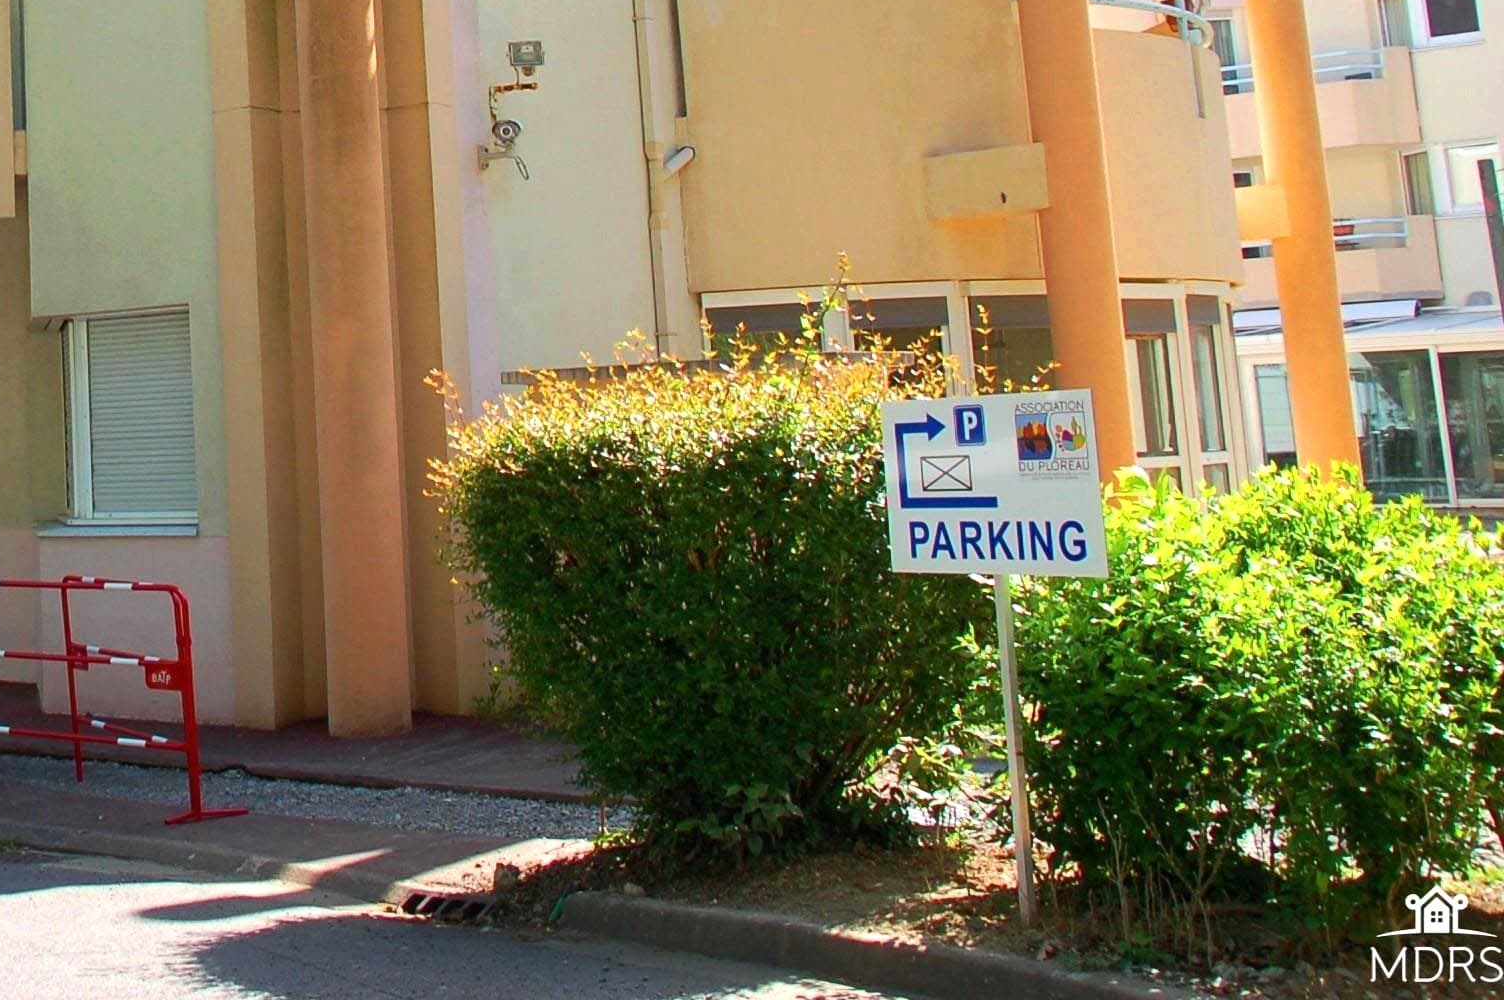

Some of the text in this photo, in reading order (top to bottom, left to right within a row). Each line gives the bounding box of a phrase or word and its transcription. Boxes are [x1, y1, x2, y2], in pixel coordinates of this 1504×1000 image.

[1015, 400, 1084, 412] ASSOCIATION
[962, 410, 978, 440] P
[1018, 460, 1090, 472] DU PLOREAU
[909, 520, 1088, 562] PARKING
